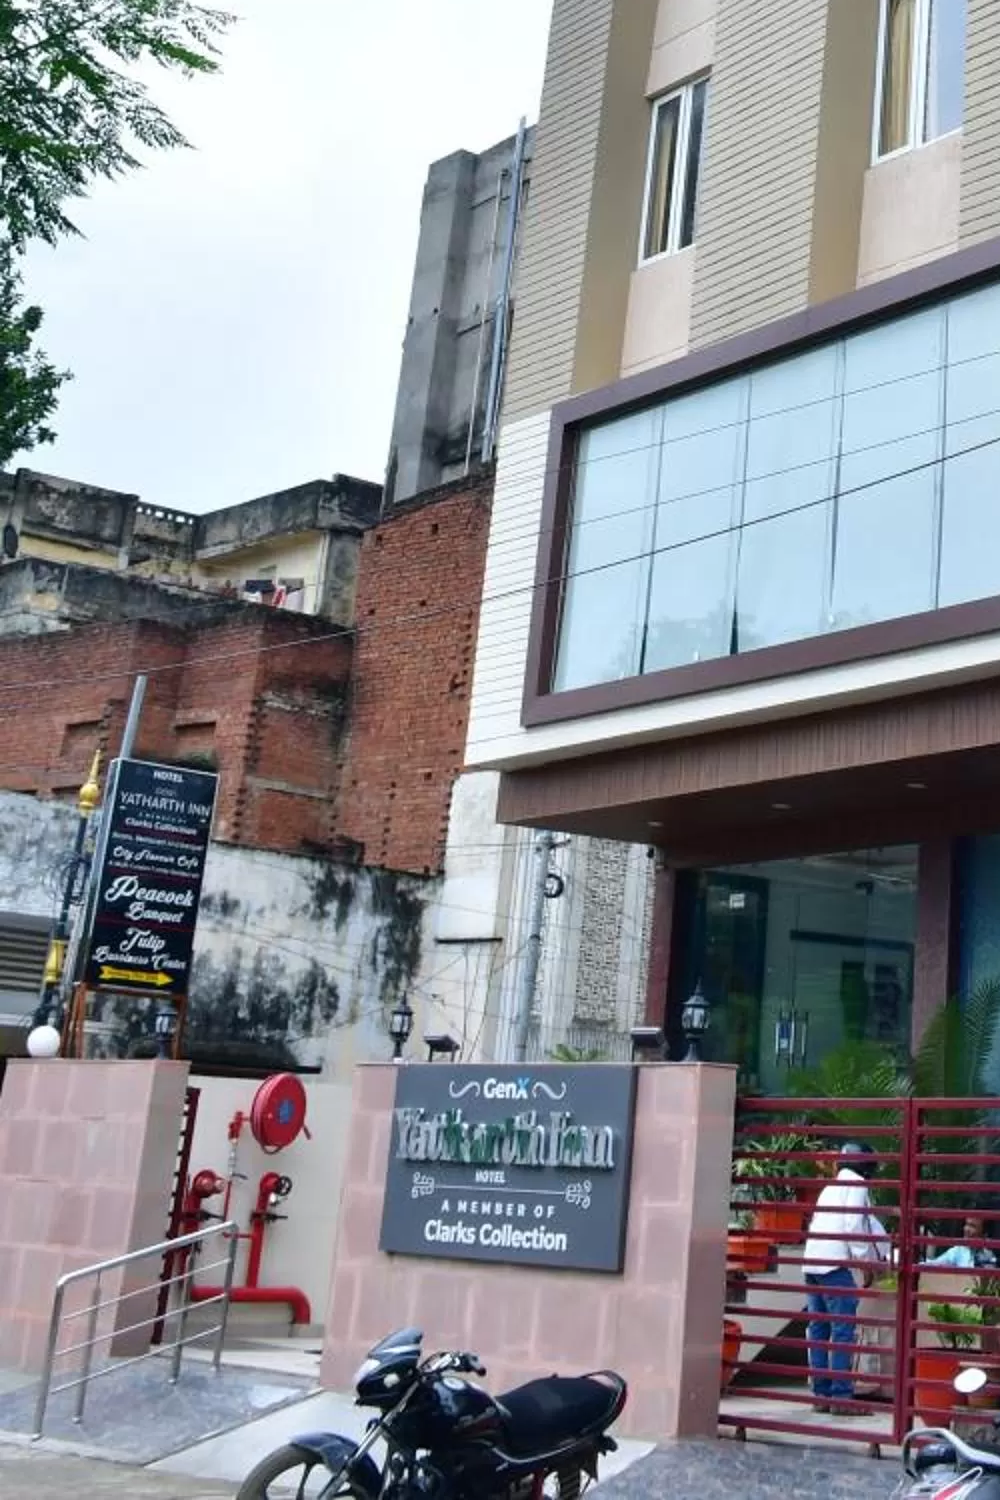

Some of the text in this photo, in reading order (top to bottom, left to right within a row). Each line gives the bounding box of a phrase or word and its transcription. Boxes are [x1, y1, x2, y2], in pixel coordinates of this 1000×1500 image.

[153, 770, 184, 783] HOTEL
[121, 791, 185, 813] YATHARTH
[188, 801, 211, 817] INN
[104, 875, 195, 907] Peacock
[124, 901, 185, 924] Banquet
[119, 926, 167, 953] Tulip
[483, 1077, 531, 1100] GenX
[475, 1169, 506, 1184] HOTEL
[441, 1198, 556, 1219] A MEMBER OF
[424, 1219, 568, 1252] Clarks Collection
